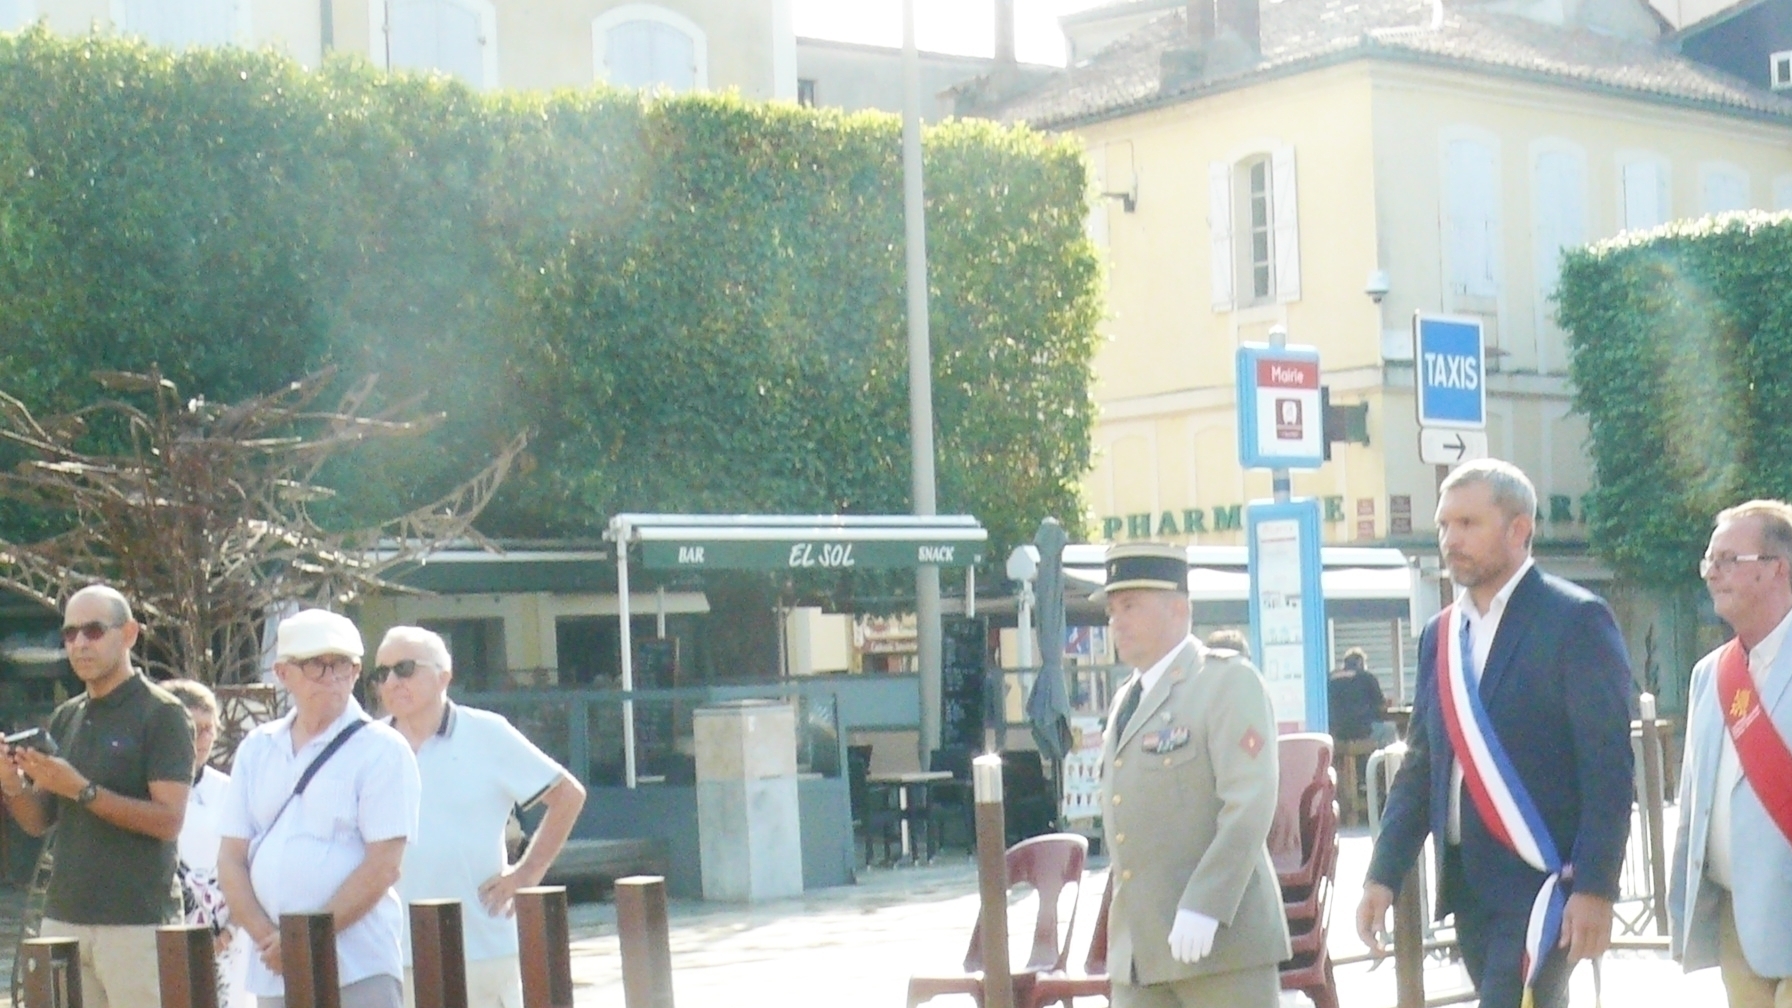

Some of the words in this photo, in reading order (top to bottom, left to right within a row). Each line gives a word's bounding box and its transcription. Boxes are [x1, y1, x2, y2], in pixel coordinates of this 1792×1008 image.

[1271, 364, 1304, 385] Mairie
[1424, 352, 1478, 391] TAXIS
[1102, 496, 1344, 540] PHARME
[678, 546, 704, 563] BAR
[788, 543, 814, 567] EL
[818, 543, 855, 567] SOL
[918, 545, 955, 562] SNACK
